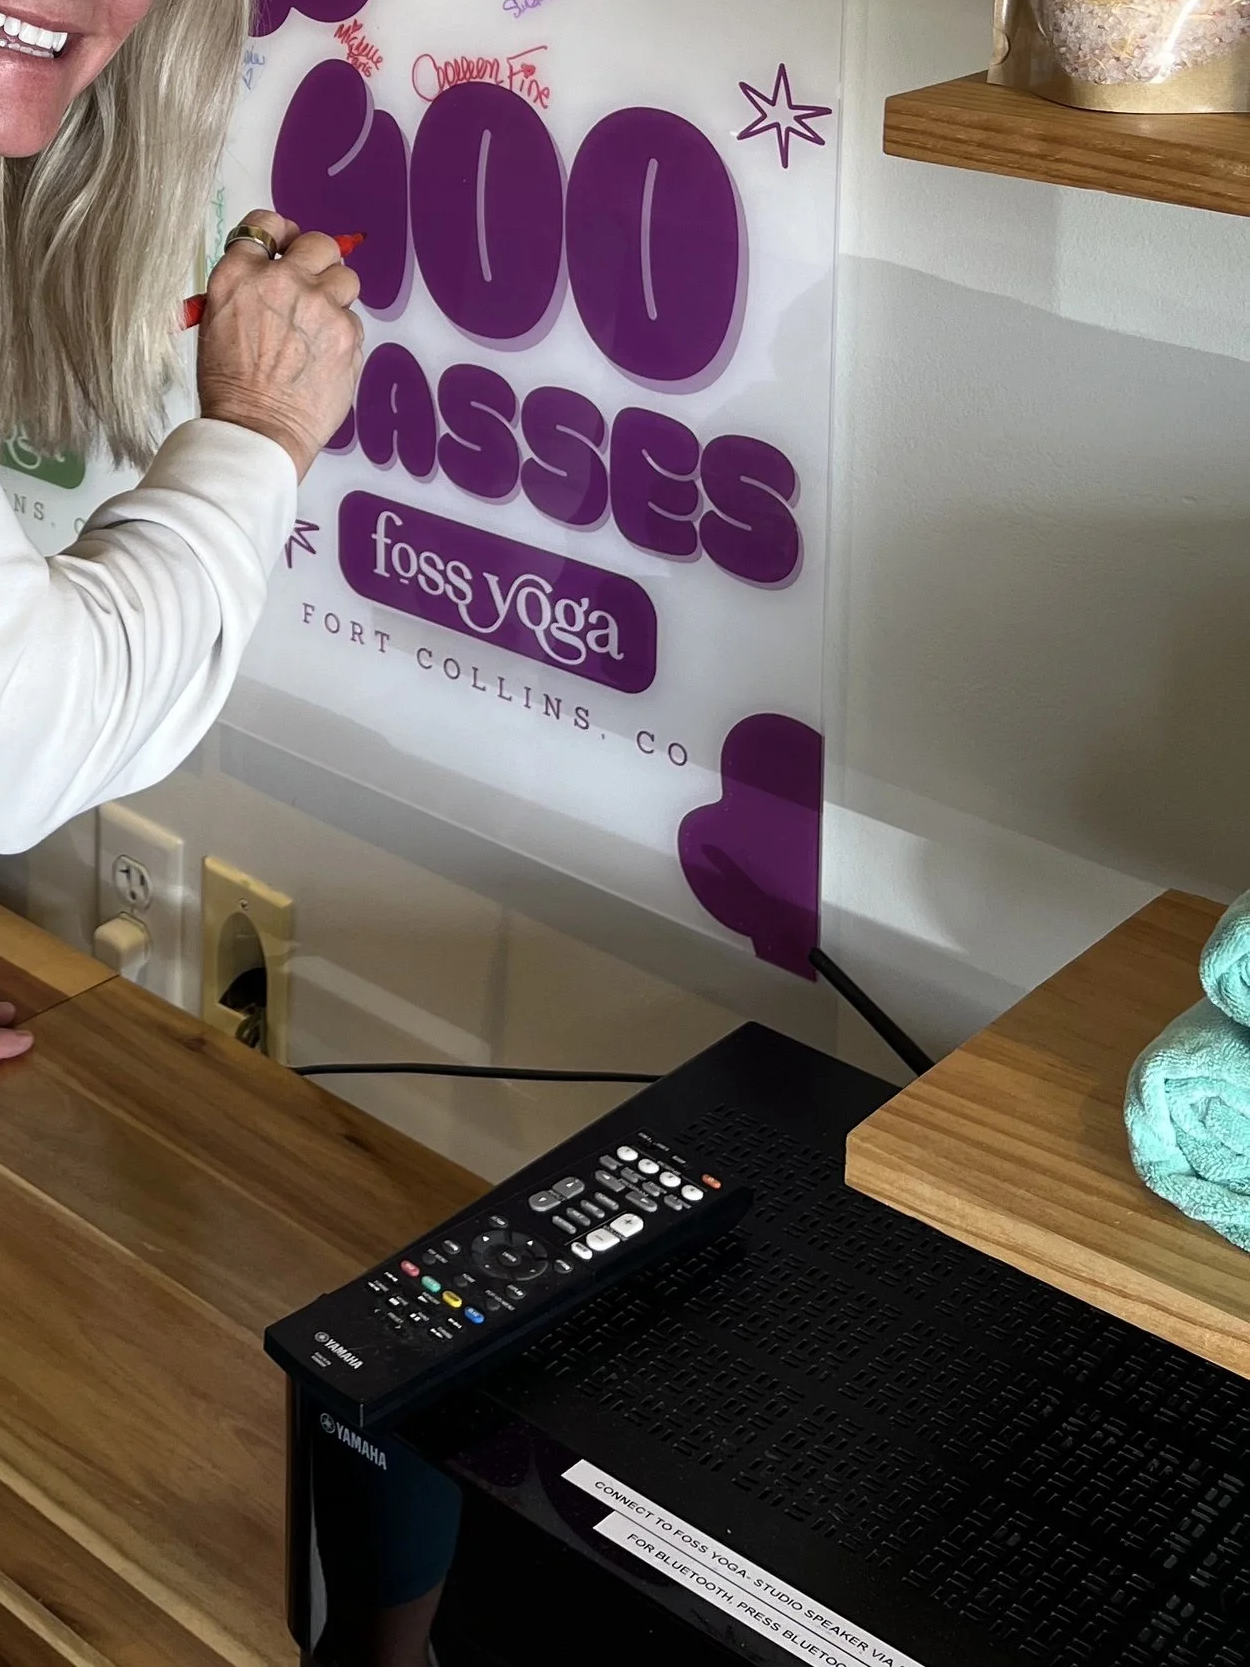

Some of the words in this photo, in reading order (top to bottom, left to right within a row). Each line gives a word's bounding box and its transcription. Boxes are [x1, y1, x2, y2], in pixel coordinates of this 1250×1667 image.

[507, 45, 550, 109] Fine
[271, 58, 749, 395] 400
[327, 341, 804, 590] ASSES
[371, 511, 473, 607] foss
[480, 573, 624, 665] yoga
[302, 603, 390, 653] FORT
[417, 648, 606, 740] COLLINS,
[637, 730, 688, 767] CO
[324, 1338, 364, 1369] YAMAHA
[336, 1422, 387, 1470] YAMAHA
[594, 1480, 653, 1519] CONNECT
[655, 1516, 673, 1532] TO
[672, 1528, 708, 1554] FOSS
[753, 1579, 803, 1611] STUDIO
[803, 1609, 869, 1651] SPEAKER
[872, 1648, 895, 1667] VIA
[626, 1533, 654, 1554] FOR
[655, 1550, 735, 1605] BLUETOOTH,
[736, 1600, 781, 1632] PRESS
